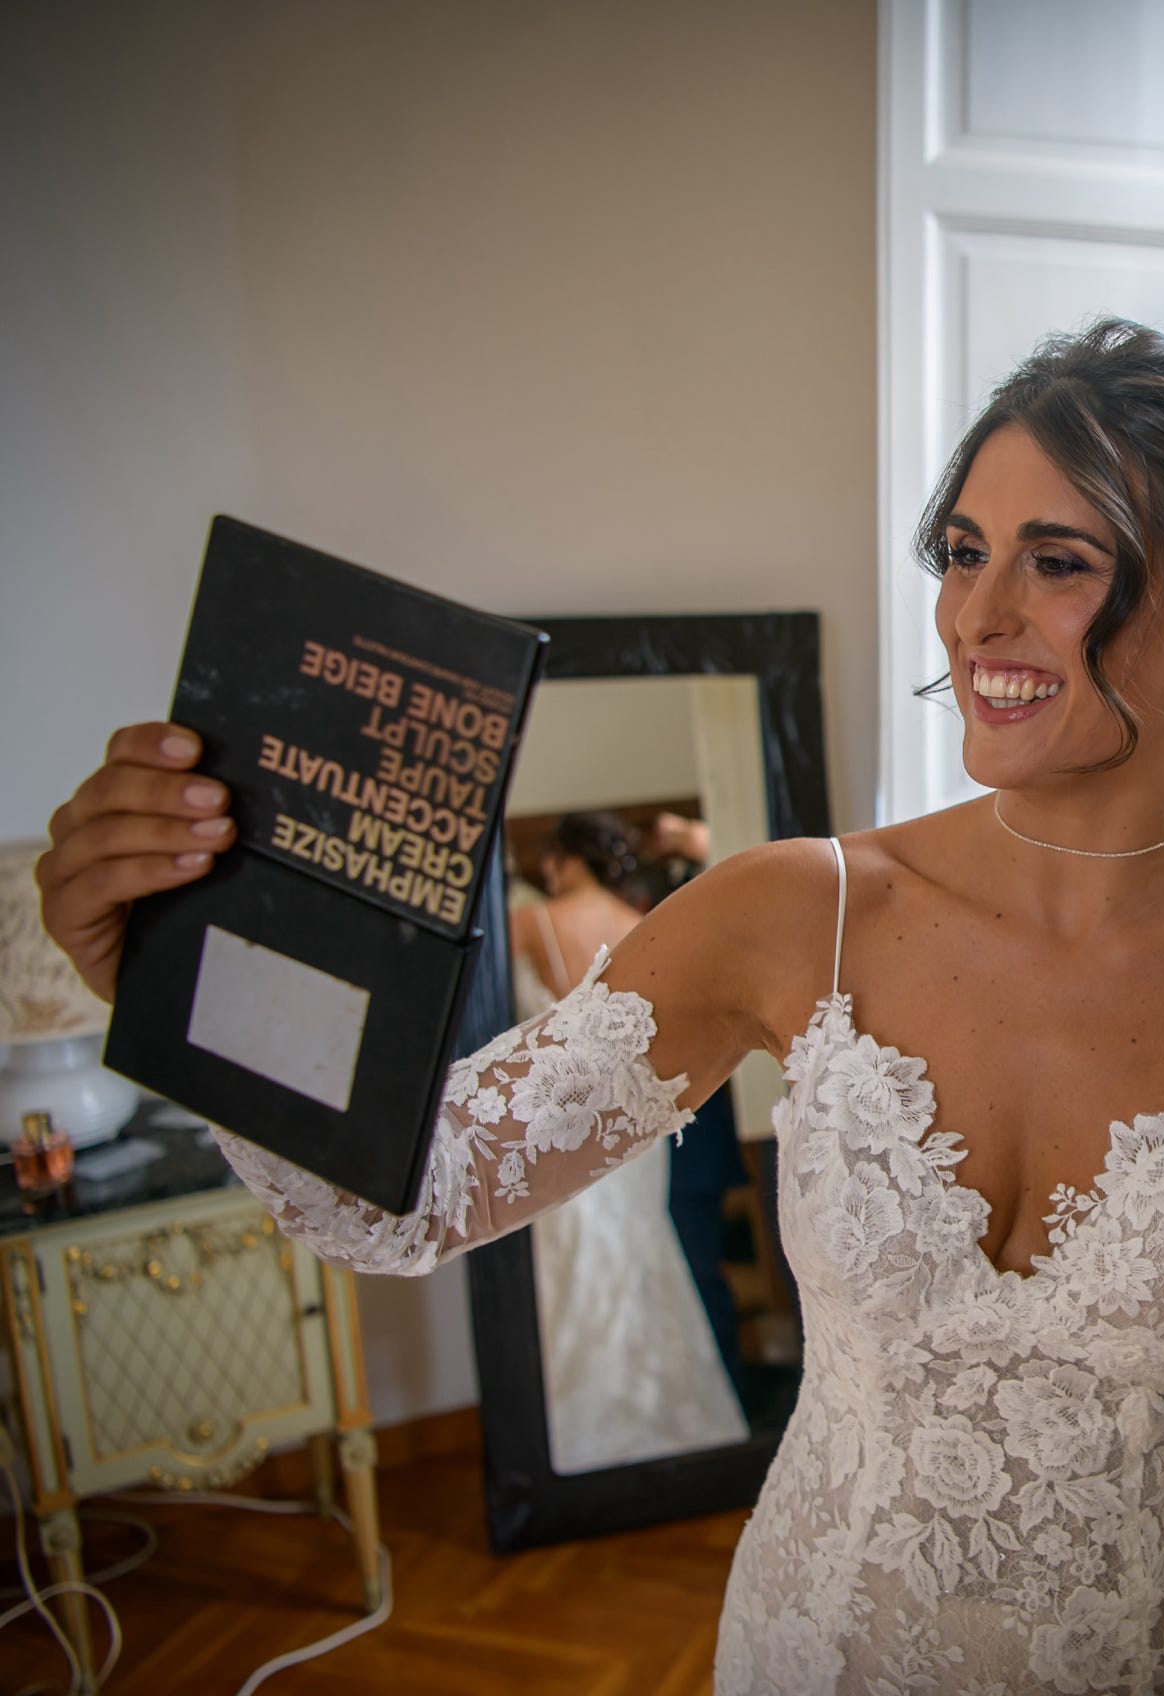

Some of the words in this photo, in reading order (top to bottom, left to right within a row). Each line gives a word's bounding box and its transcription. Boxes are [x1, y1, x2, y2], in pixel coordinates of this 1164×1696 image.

[300, 640, 404, 708] BEIGE
[360, 706, 500, 784] SCULPT
[406, 683, 509, 748] BONE
[258, 734, 485, 852] ACCENTUATE
[377, 747, 488, 820] TAUPE
[271, 813, 467, 925] EMPHASIZE
[348, 811, 474, 888] CREAM
